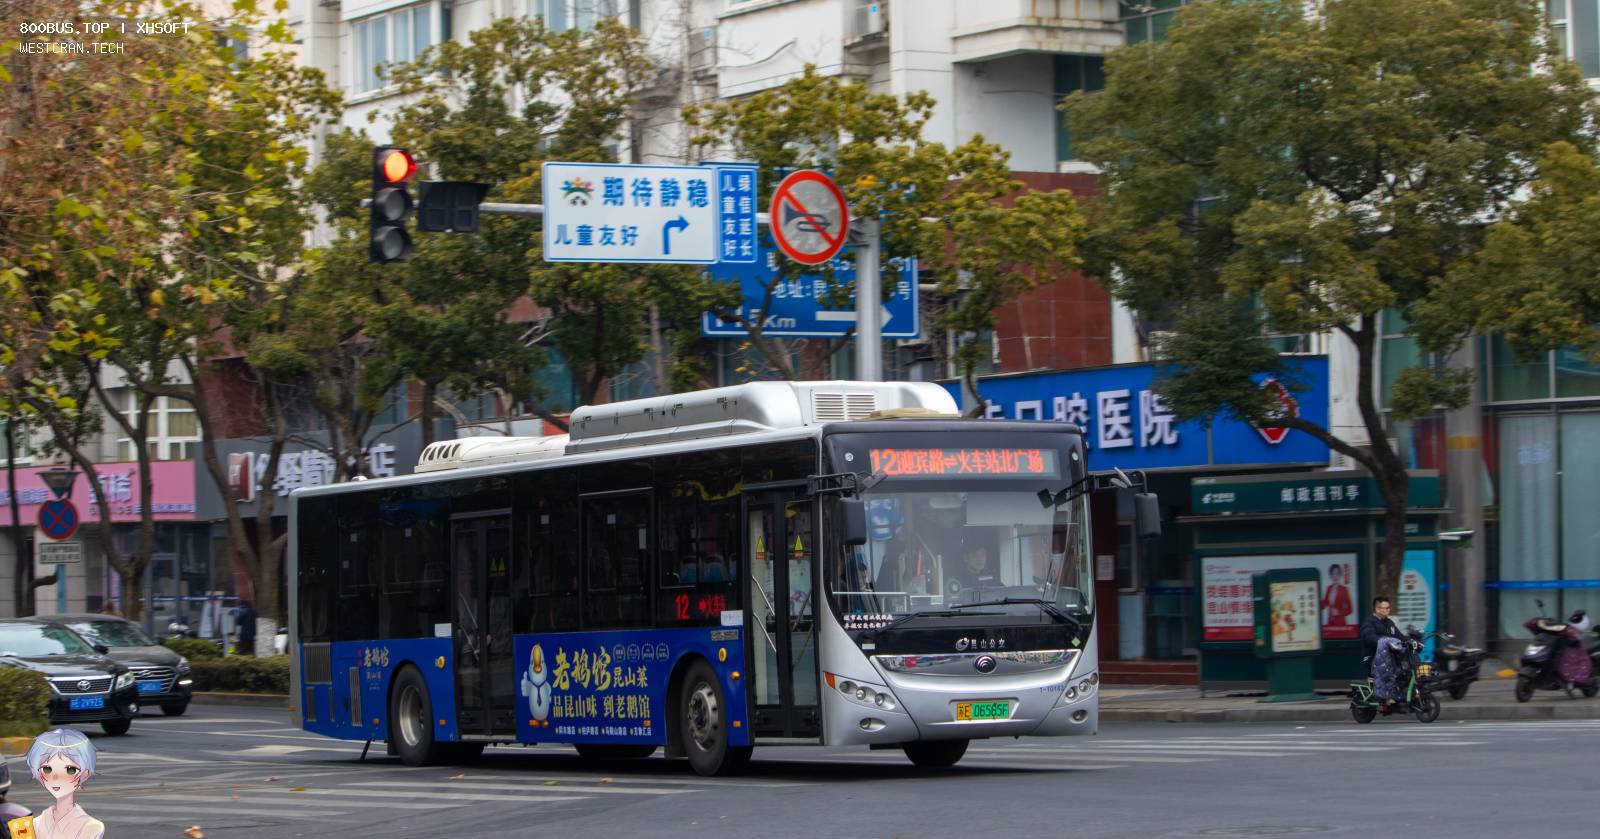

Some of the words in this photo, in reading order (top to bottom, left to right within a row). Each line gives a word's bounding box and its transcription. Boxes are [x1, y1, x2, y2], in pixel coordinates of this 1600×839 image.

[722, 174, 736, 257] 儿童友好
[554, 223, 639, 246] 儿童友好
[869, 449, 897, 476] 12
[1280, 485, 1360, 503] 邮政报刊亭
[675, 593, 691, 620] 12
[971, 637, 1005, 649] 昆山公交
[553, 695, 598, 718] 品昆山味
[603, 694, 651, 719] 到老鹅馆
